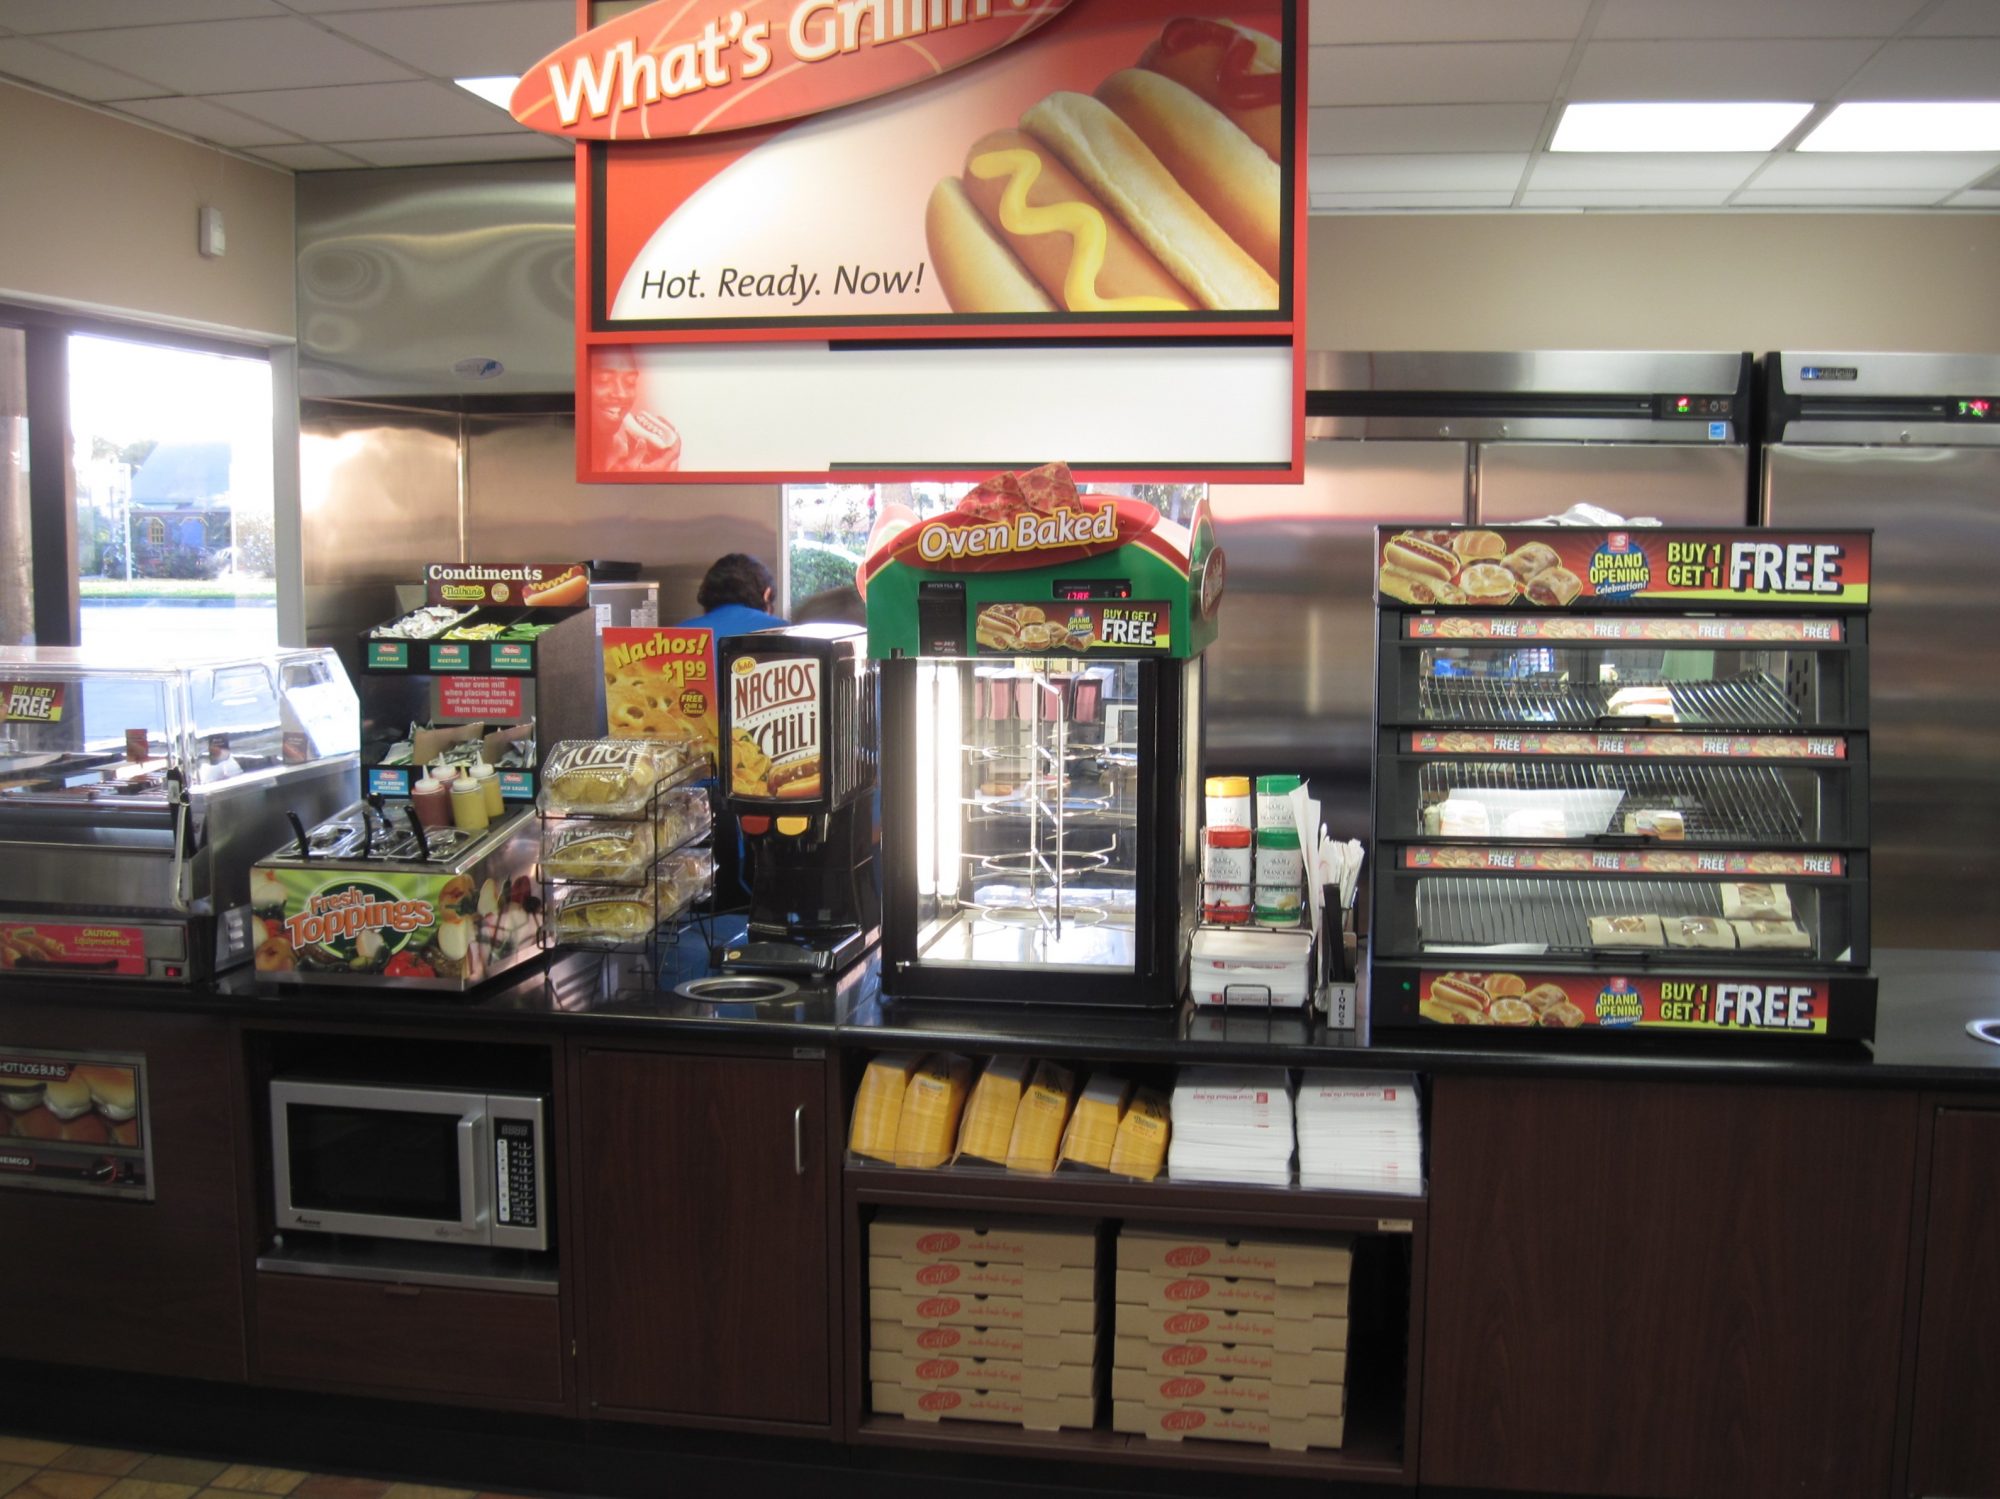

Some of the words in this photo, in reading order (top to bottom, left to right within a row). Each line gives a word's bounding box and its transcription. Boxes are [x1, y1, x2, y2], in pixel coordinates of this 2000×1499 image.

[549, 12, 771, 127] What's
[641, 270, 706, 299] Hot.
[717, 264, 822, 306] Ready.
[833, 262, 925, 296] Now!
[920, 524, 1009, 558] Oven
[1016, 504, 1115, 548] Baked
[1594, 552, 1643, 569] GRAND
[1667, 543, 1707, 564] BUY
[1713, 543, 1721, 565] 1
[428, 564, 543, 581] Condiments
[1729, 542, 1840, 592] FREE
[1589, 567, 1650, 584] OPENING
[1667, 565, 1705, 586] GET
[1710, 566, 1719, 587] 1
[1595, 580, 1647, 595] Celebration!
[1069, 616, 1090, 624] GRAND
[1103, 608, 1124, 619] BUY
[1125, 610, 1129, 620] 1
[1131, 611, 1150, 621] GET
[1152, 612, 1157, 622] 1
[1067, 623, 1094, 631] OPENING
[1101, 619, 1154, 645] FREE
[1490, 624, 1518, 637] FREE
[1594, 625, 1621, 638] FREE
[1698, 625, 1725, 639] FREE
[1802, 626, 1831, 639] FREE
[610, 632, 709, 669] Nachos!
[13, 685, 29, 695] BUY
[30, 687, 34, 696] 1
[34, 687, 51, 697] GET
[51, 688, 56, 698] 1
[444, 689, 463, 697] when
[464, 689, 490, 698] placing
[681, 694, 704, 703] FREE
[735, 663, 816, 720] NACHOS
[8, 694, 52, 718] FREE
[481, 698, 514, 706] removing
[1493, 738, 1521, 751] FREE
[1597, 740, 1624, 753] FREE
[1702, 741, 1730, 755] FREE
[1807, 742, 1835, 755] FREE
[1487, 854, 1515, 868] FREE
[1592, 856, 1620, 869] FREE
[1698, 857, 1725, 871] FREE
[1803, 859, 1832, 873] FREE
[310, 886, 363, 915] Fresh
[285, 896, 435, 950] Toppings
[1600, 992, 1638, 1006] GRAND
[1661, 982, 1696, 1001] BUY
[1700, 983, 1708, 1002] 1
[1338, 989, 1346, 1026] TONGS
[1595, 1004, 1643, 1018] OPENING
[1660, 1002, 1694, 1021] GET
[1698, 1002, 1706, 1021] 1
[1714, 983, 1812, 1027] FREE
[1599, 1015, 1641, 1027] Celebration!
[20, 1063, 39, 1074] DOG
[41, 1064, 65, 1077] BUNS
